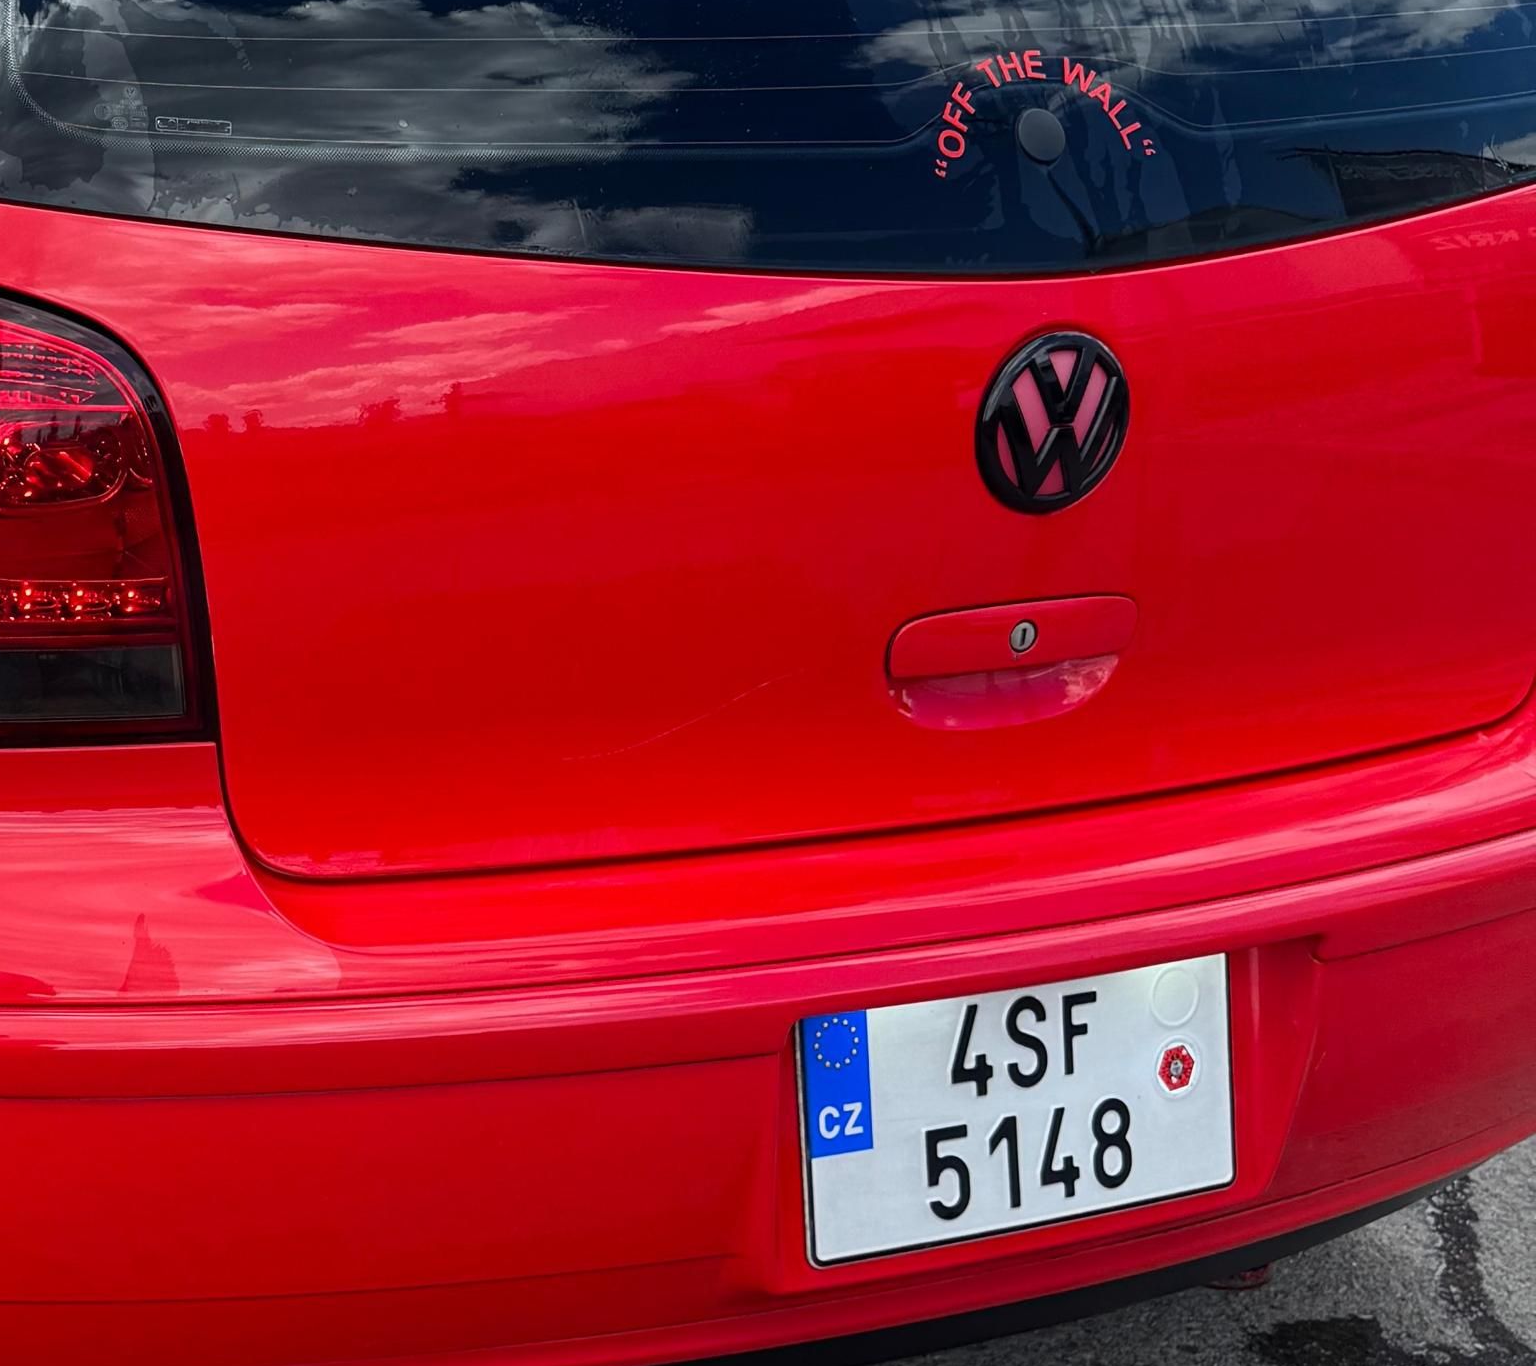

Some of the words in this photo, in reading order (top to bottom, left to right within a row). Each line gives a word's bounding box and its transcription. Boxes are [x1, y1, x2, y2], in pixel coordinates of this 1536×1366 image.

[975, 49, 1047, 89] THE
[951, 990, 1098, 1097] 4SF
[818, 1102, 864, 1140] CZ
[924, 1098, 1133, 1221] 5148
